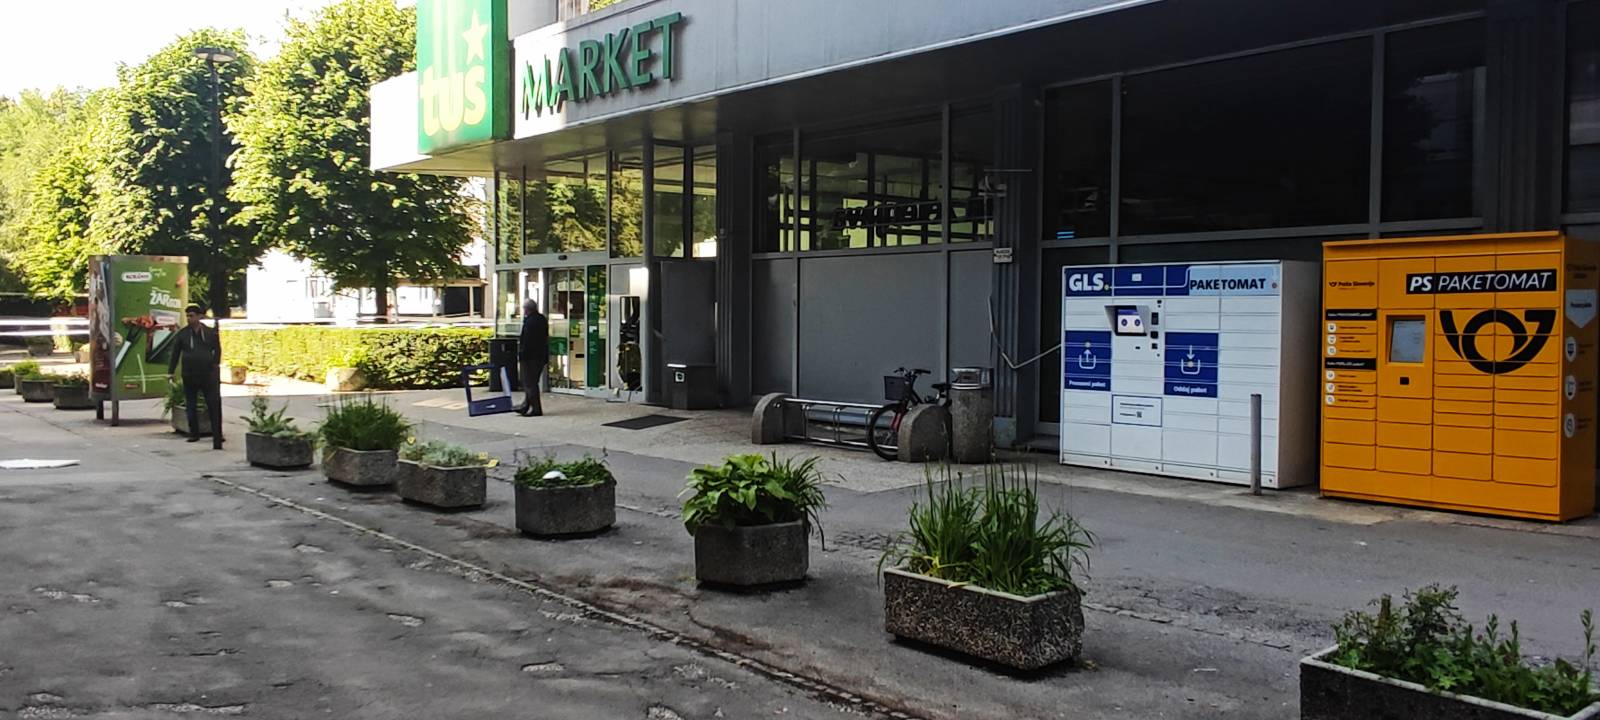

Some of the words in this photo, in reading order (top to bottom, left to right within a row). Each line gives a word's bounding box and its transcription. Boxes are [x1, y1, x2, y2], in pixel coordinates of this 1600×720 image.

[522, 12, 681, 118] MARKET
[1190, 279, 1266, 290] PAKETOMAT
[1410, 276, 1433, 292] PS
[1438, 272, 1552, 291] PAKETOMAT
